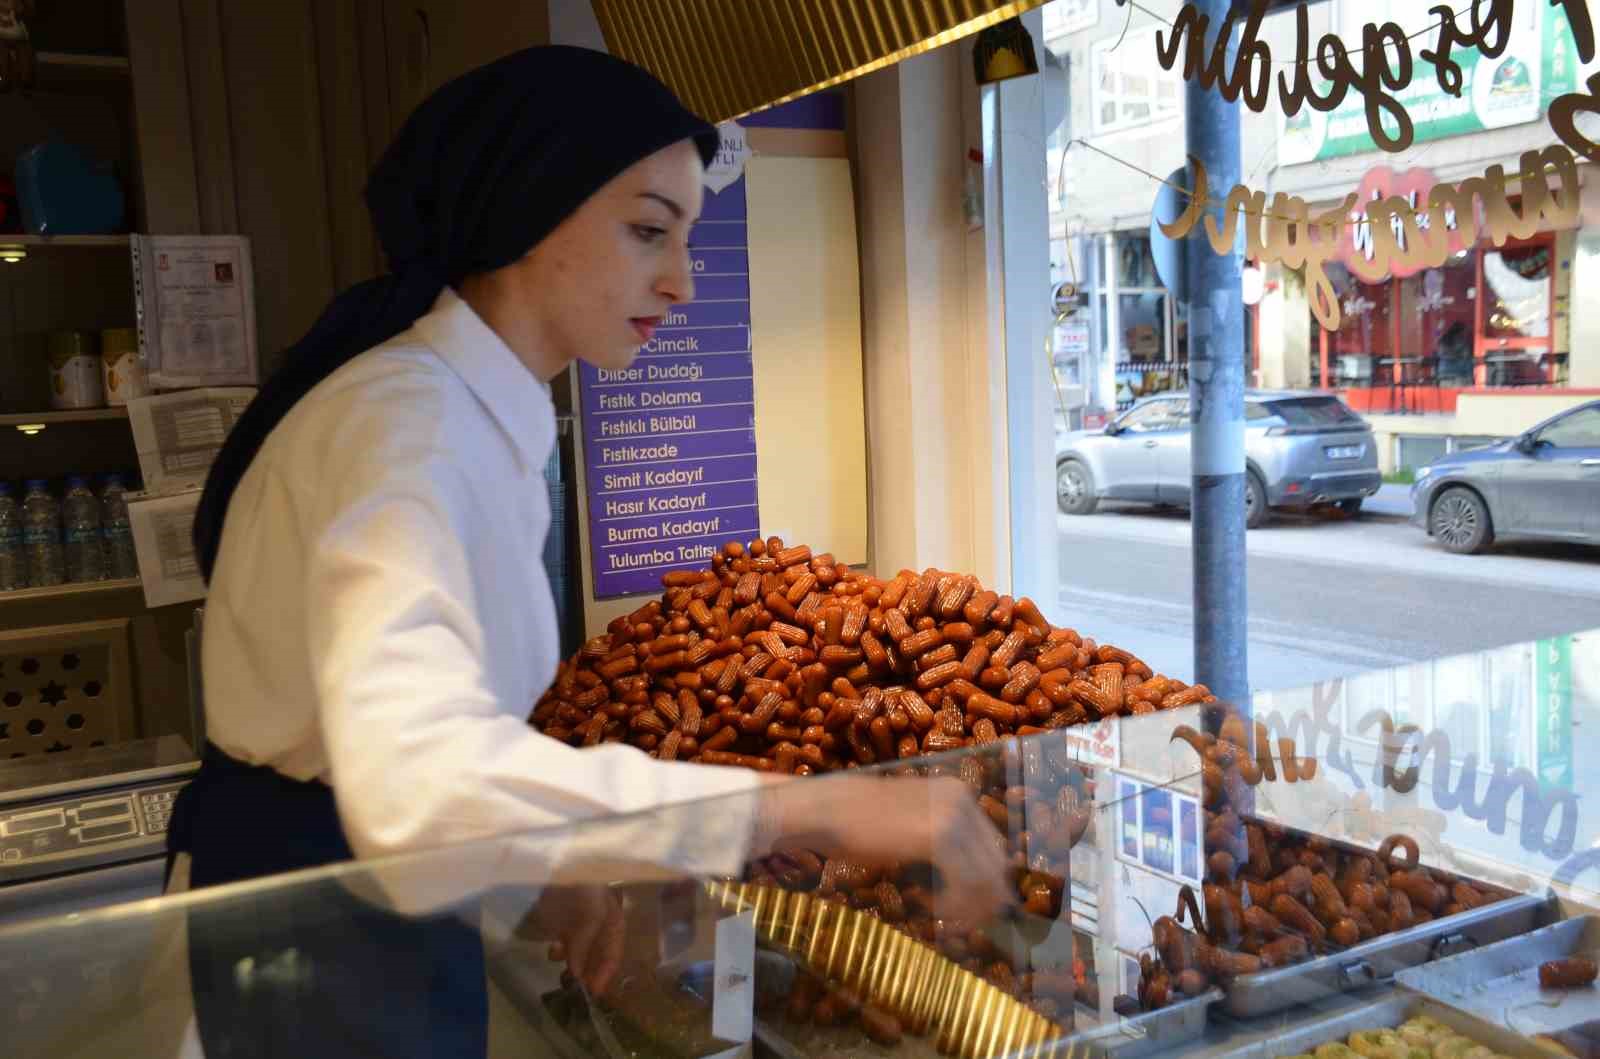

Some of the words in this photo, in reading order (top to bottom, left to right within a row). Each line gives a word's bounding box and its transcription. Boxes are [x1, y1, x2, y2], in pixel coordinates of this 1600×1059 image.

[648, 362, 703, 381] Dudağı
[599, 394, 637, 409] Fıstık
[641, 390, 702, 407] Dolama
[601, 419, 646, 436] Fıstıklı
[650, 416, 696, 432] Bülbül
[602, 443, 679, 463] Fıstıkzade
[604, 473, 641, 489] Simit
[645, 467, 705, 487] Kadayıf
[606, 500, 645, 516] Hasır
[648, 493, 707, 512] Kadayıf
[608, 526, 658, 542] Burma
[662, 517, 720, 535] Kadayıf
[609, 549, 675, 569] Tulumba
